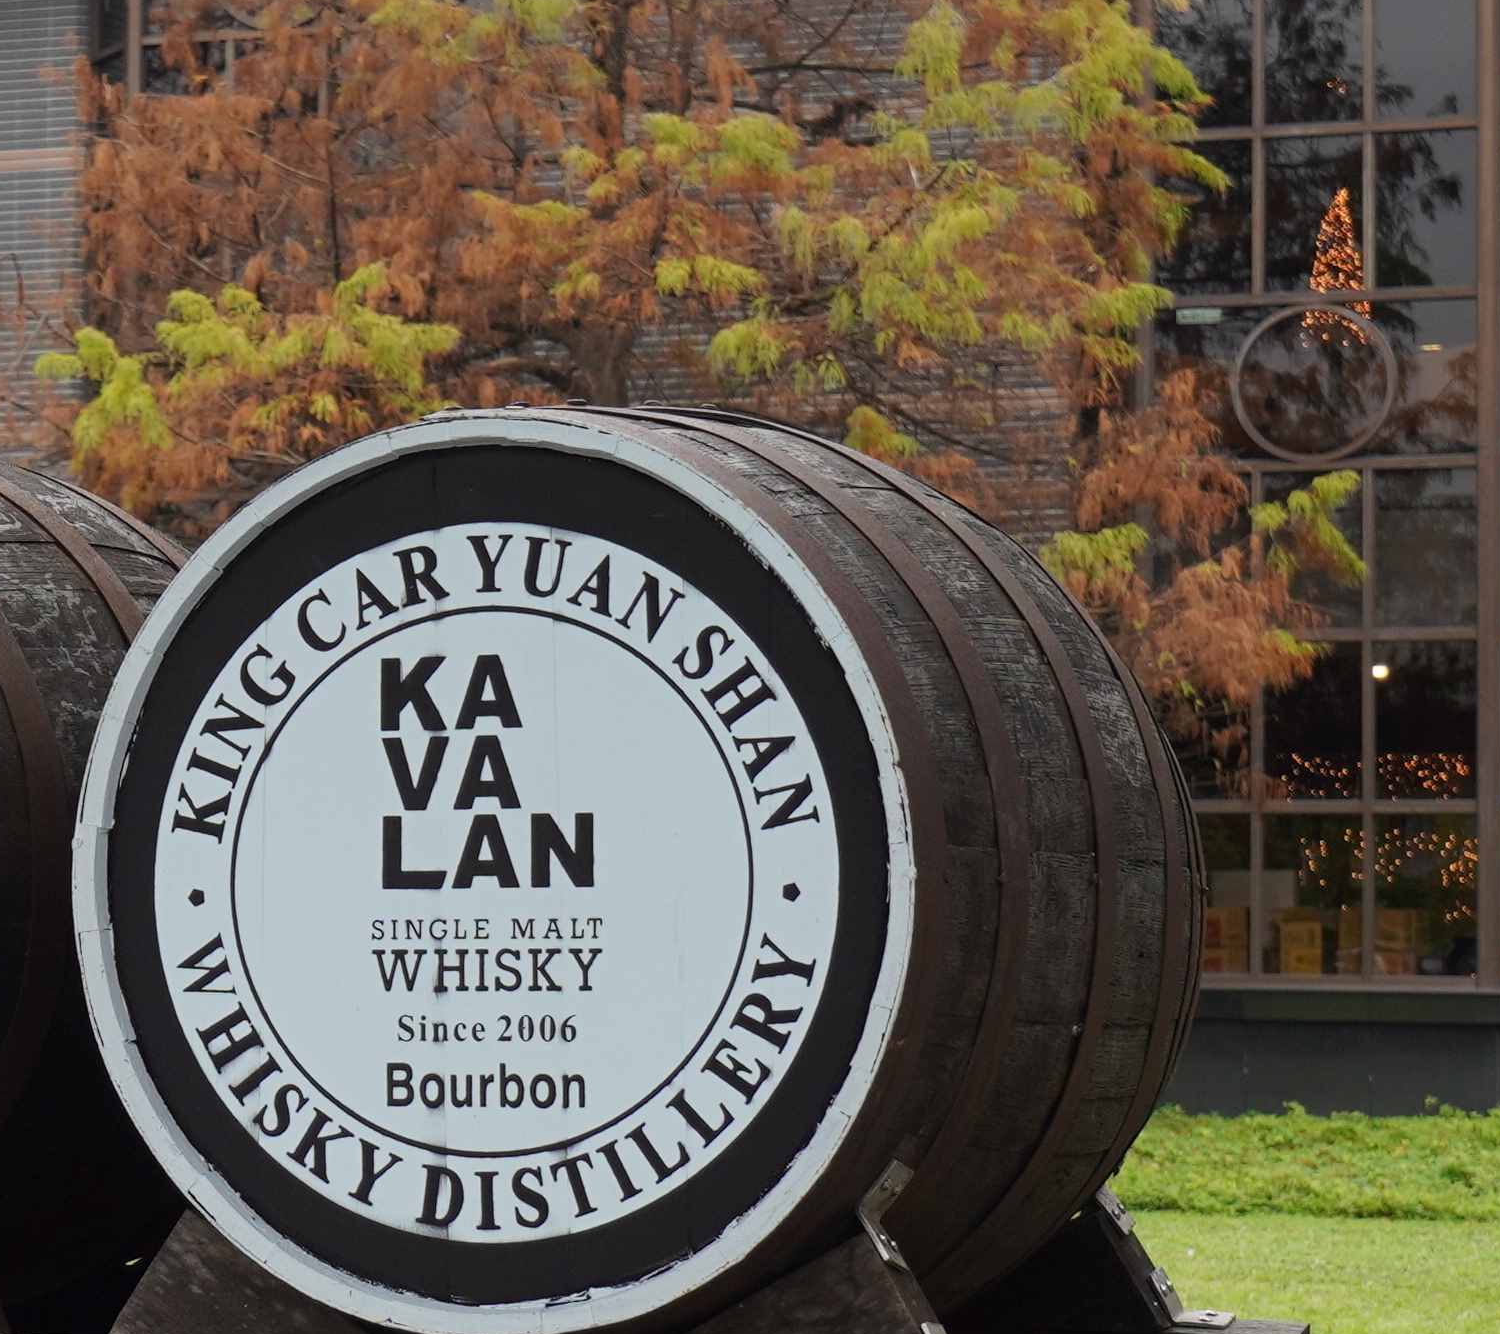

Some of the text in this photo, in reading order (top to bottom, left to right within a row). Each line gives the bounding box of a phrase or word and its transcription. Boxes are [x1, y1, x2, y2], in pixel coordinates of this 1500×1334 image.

[172, 535, 820, 844] KING CAR YUAN SHAN
[381, 655, 522, 732] KA
[382, 735, 521, 810] VA
[383, 813, 594, 890] LAN
[372, 918, 602, 941] SINGLE MALT
[372, 949, 602, 995] WHISKY
[399, 1015, 576, 1042] Since 2006
[177, 933, 816, 1230] WHISKY DISTILLERY
[387, 1063, 585, 1109] Bourbon
